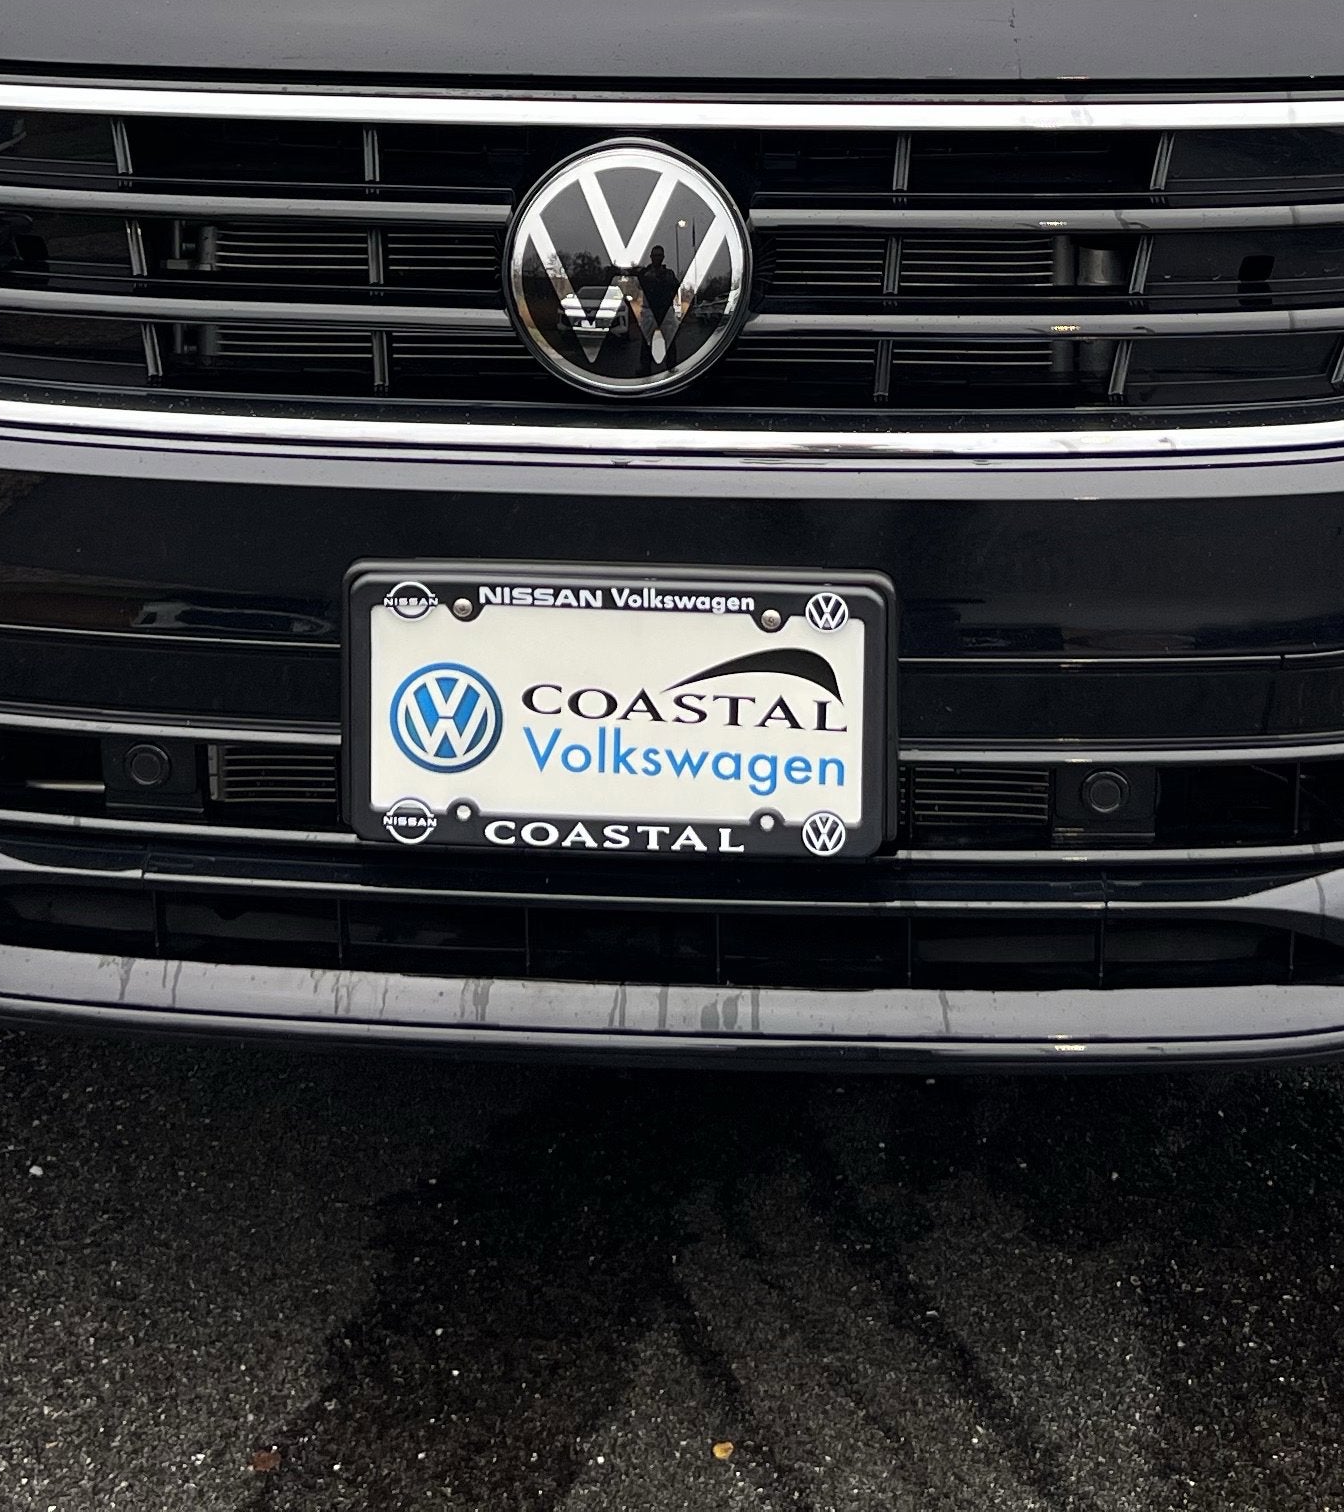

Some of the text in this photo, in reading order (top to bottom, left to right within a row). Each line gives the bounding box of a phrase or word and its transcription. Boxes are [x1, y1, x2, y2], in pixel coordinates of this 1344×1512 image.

[383, 597, 439, 607] NISSAN
[478, 585, 755, 614] NISSAN Volkswagen
[521, 684, 848, 733] COASTAL
[522, 726, 846, 796] Volkswagen
[383, 816, 438, 827] NISSAN
[484, 819, 745, 854] COASTAL
